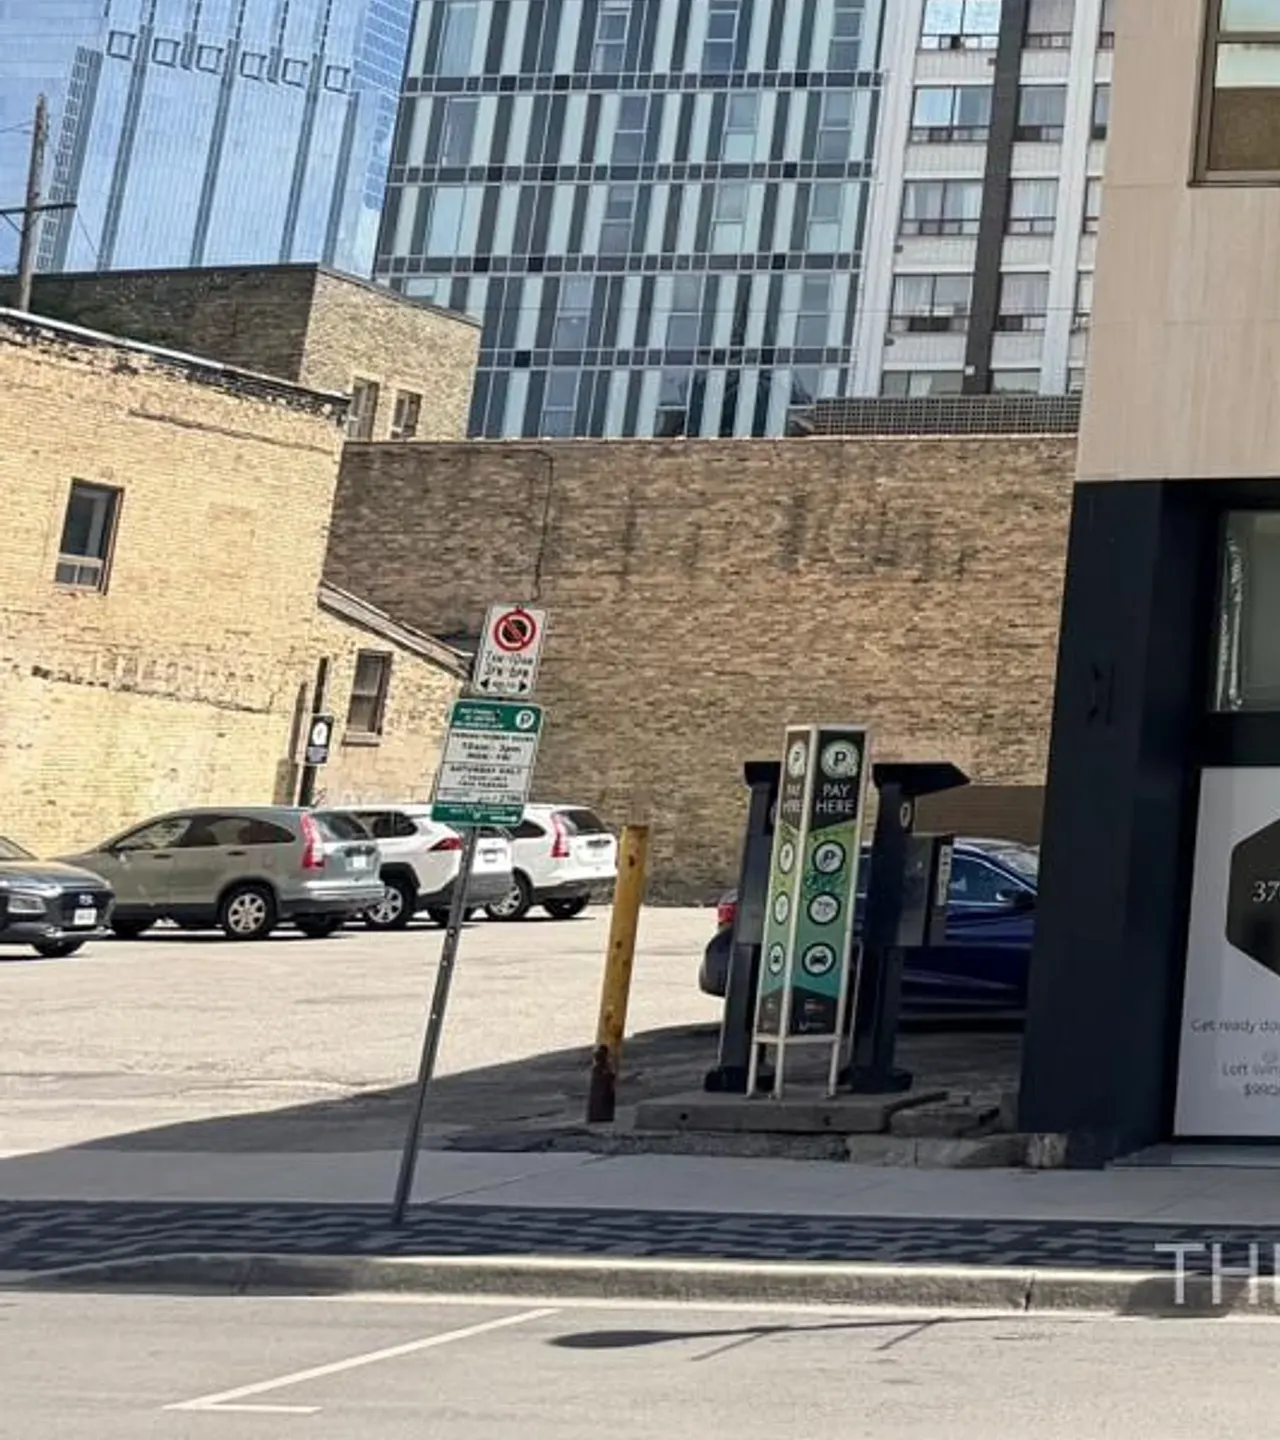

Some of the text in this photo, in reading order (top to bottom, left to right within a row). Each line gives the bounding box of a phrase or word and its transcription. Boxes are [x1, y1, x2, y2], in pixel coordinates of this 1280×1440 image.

[822, 783, 851, 798] PAY
[815, 799, 856, 814] HERE
[1191, 1019, 1216, 1033] Get
[1218, 1020, 1255, 1034] ready
